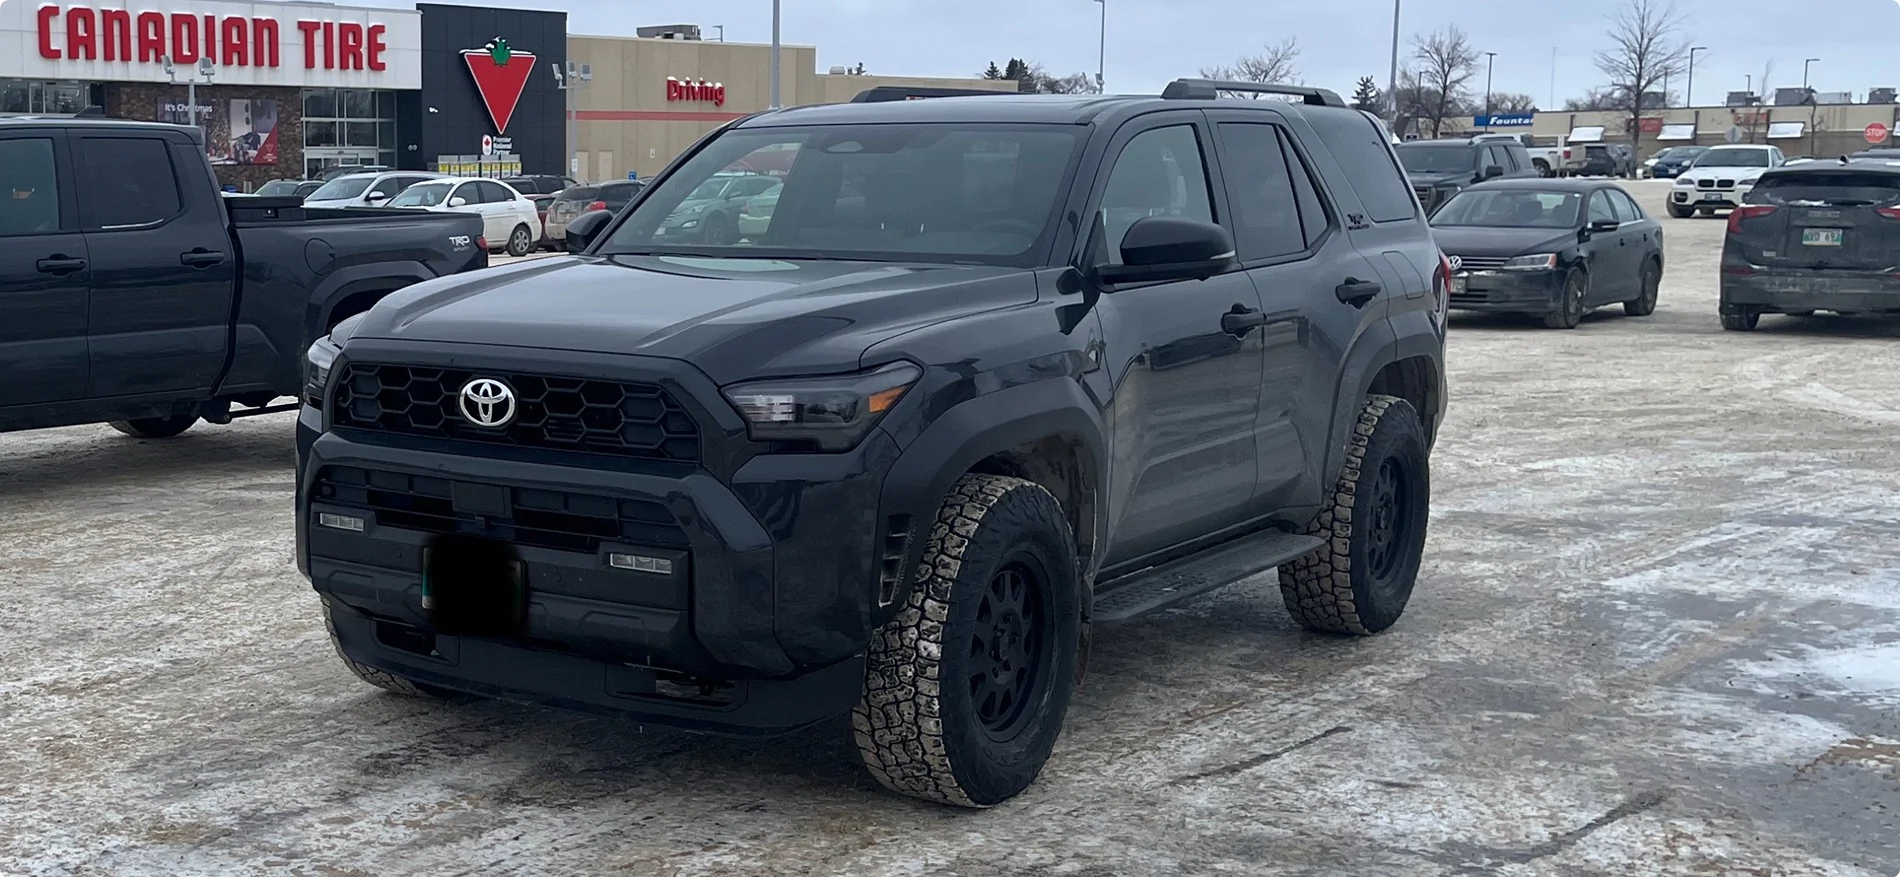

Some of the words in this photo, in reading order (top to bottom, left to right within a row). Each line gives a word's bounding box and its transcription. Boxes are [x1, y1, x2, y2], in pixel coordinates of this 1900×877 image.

[37, 5, 280, 68] CANADIAN
[297, 19, 387, 71] TIRE
[667, 77, 725, 107] Driving
[176, 103, 213, 113] Chrtmas
[1865, 128, 1886, 137] STOP
[448, 235, 470, 246] TRD
